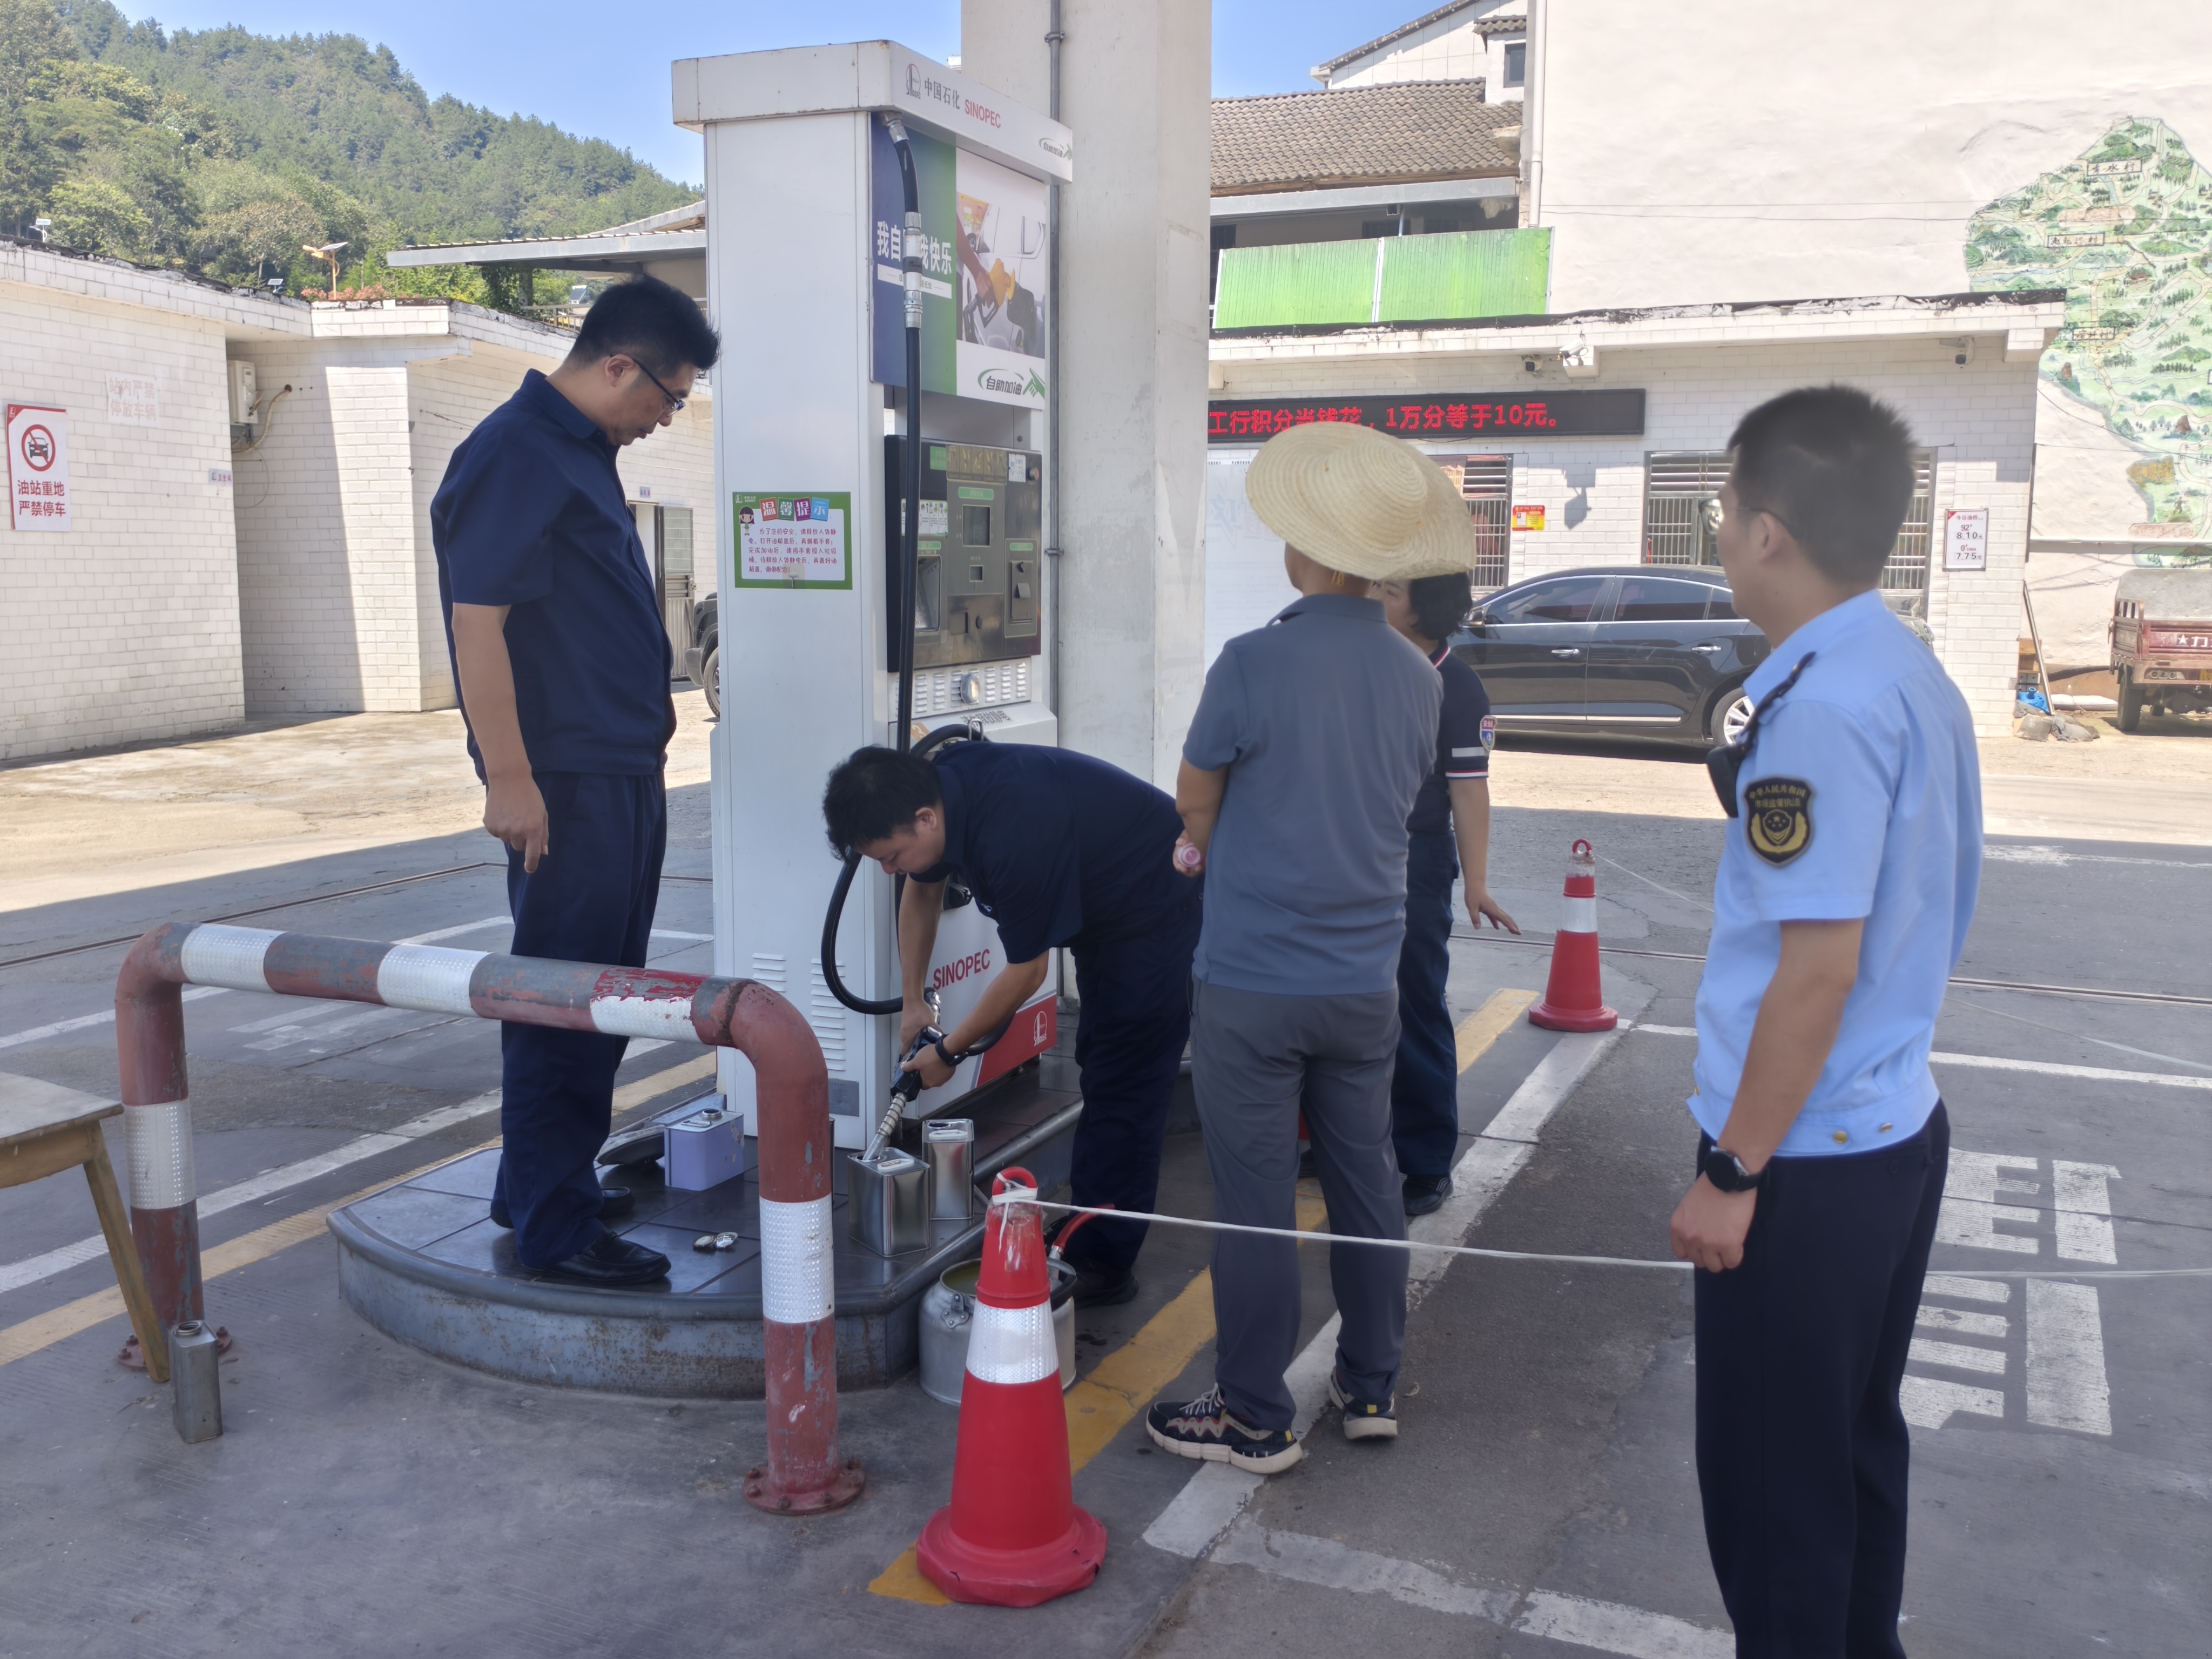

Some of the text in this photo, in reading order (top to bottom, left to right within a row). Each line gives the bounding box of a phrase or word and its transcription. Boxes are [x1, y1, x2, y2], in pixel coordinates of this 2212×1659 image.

[924, 77, 1002, 129] 中国石化 SINOPEC
[876, 220, 953, 275] 我自我快乐
[986, 375, 1022, 395] 自助加油
[17, 480, 65, 496] 油站重地
[18, 500, 66, 517] 严禁停车
[762, 500, 826, 516] 温馨提示
[933, 948, 990, 991] SINOPEC
